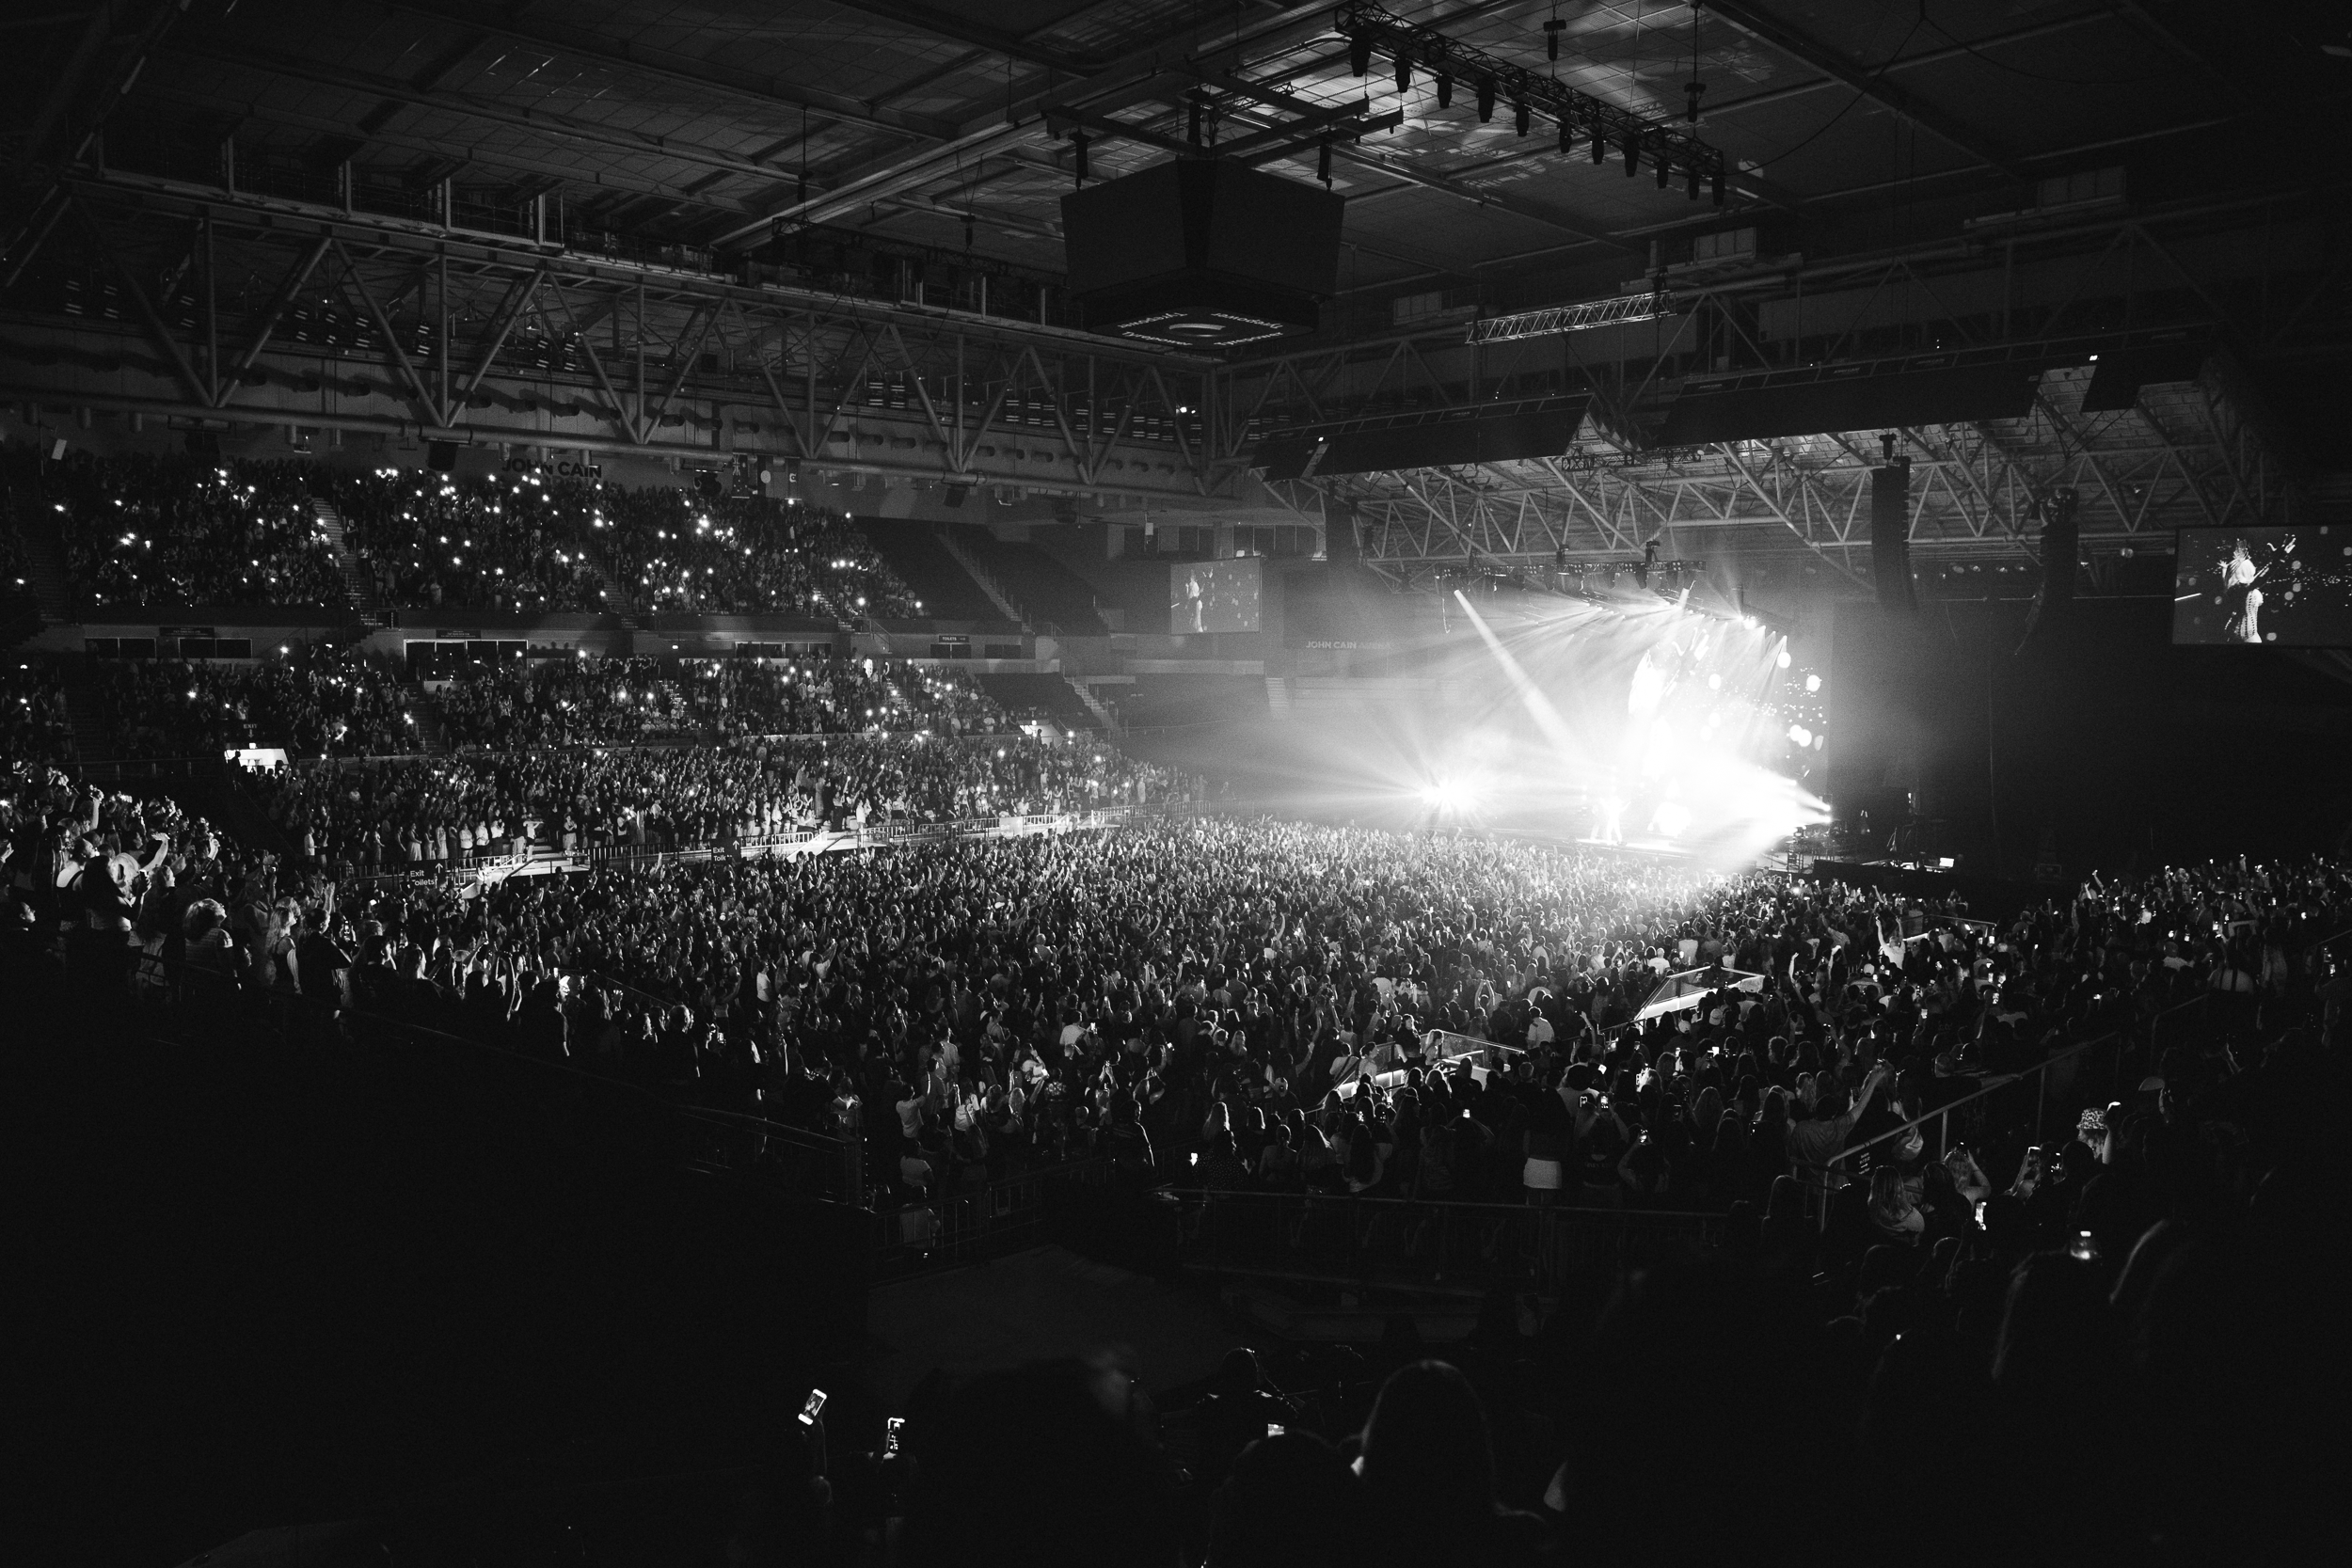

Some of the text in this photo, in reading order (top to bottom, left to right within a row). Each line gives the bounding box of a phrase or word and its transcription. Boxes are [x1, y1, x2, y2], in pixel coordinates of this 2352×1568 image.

[501, 458, 602, 478] JOHN CAIN
[1306, 641, 1331, 649] JOHN
[410, 869, 424, 878] Exit
